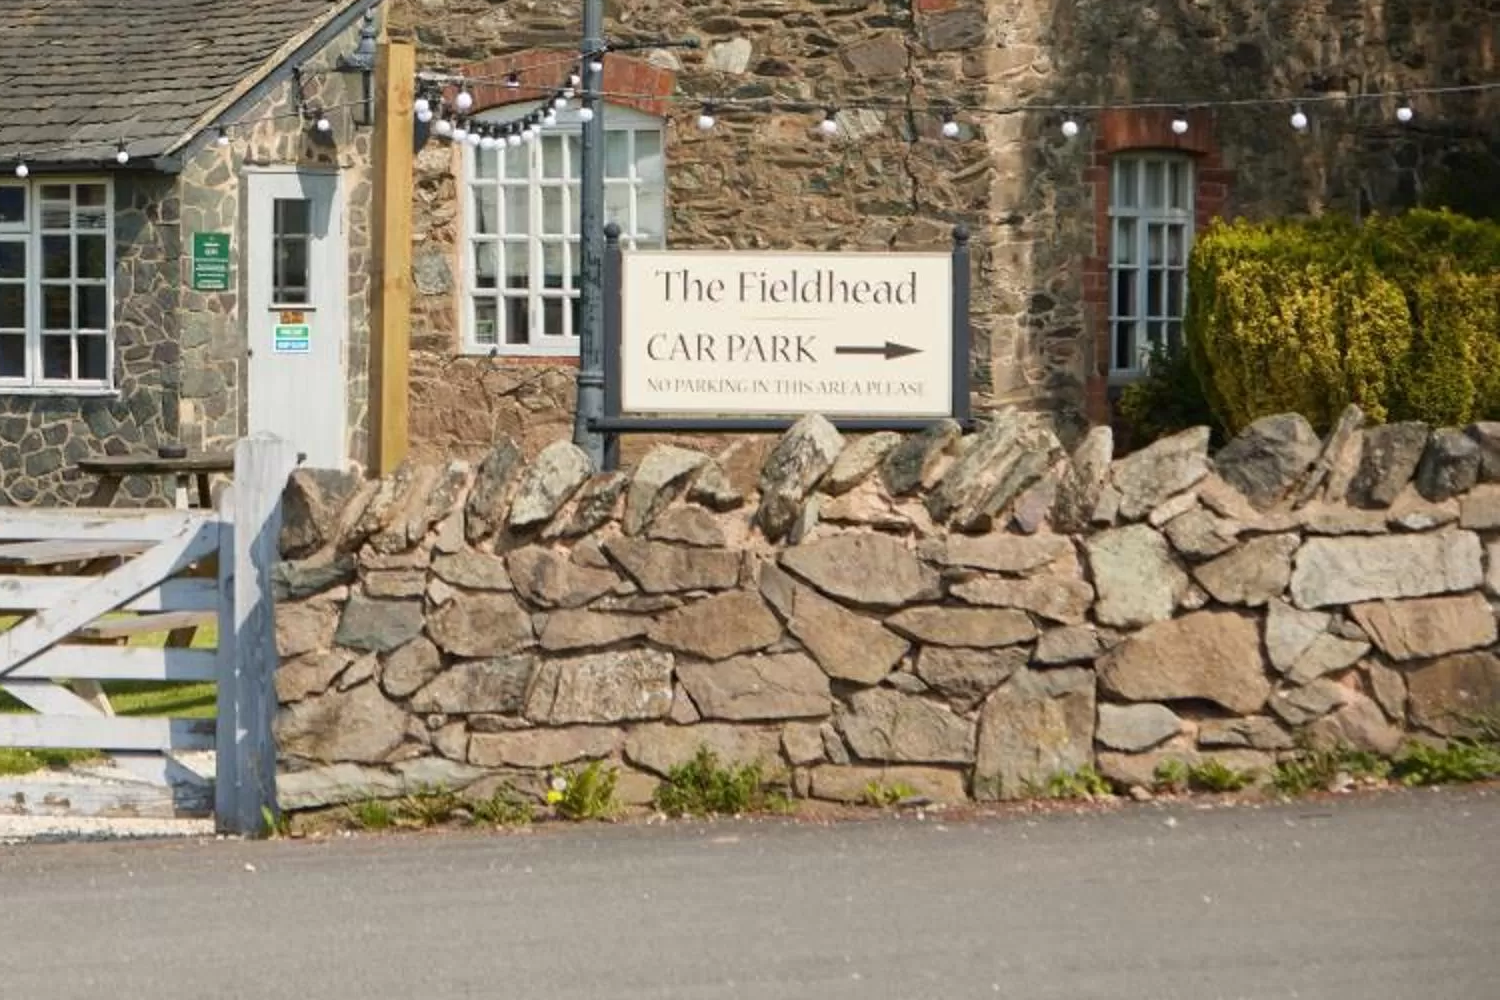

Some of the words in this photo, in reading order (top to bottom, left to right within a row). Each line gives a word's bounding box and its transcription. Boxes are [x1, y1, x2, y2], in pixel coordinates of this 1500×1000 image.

[655, 269, 725, 303] The
[739, 269, 918, 305] Fieldhead
[647, 332, 716, 363] CAR
[727, 334, 819, 364] PARK
[647, 378, 671, 394] NO
[674, 378, 748, 395] PARKING
[752, 379, 769, 394] IN
[774, 380, 814, 396] THIS
[817, 380, 861, 397] AREA
[866, 381, 924, 397] PLEASE
